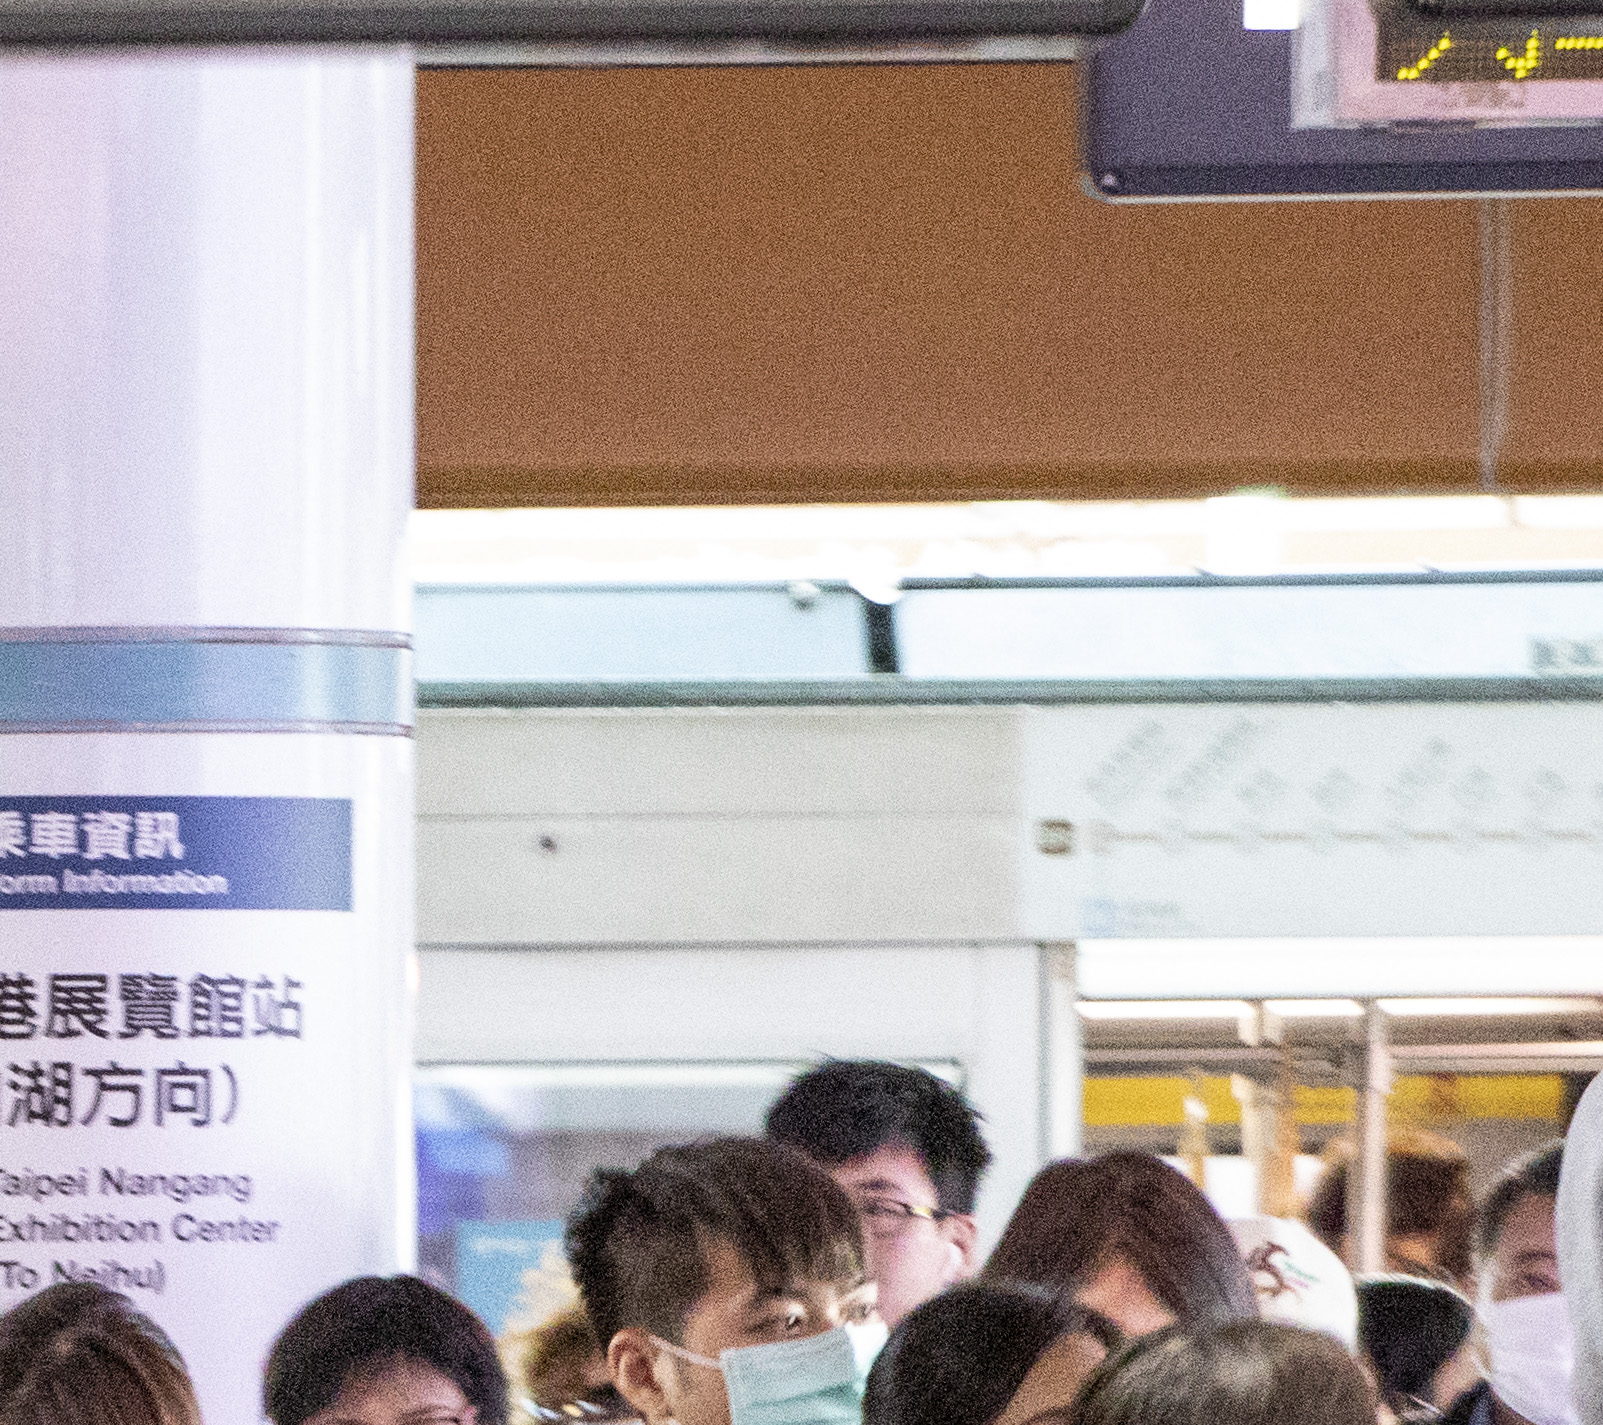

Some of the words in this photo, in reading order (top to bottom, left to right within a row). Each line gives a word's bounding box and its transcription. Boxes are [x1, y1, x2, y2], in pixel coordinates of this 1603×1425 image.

[62, 868, 229, 896] Information
[98, 1166, 251, 1205] Nangang
[170, 1211, 279, 1244] Center
